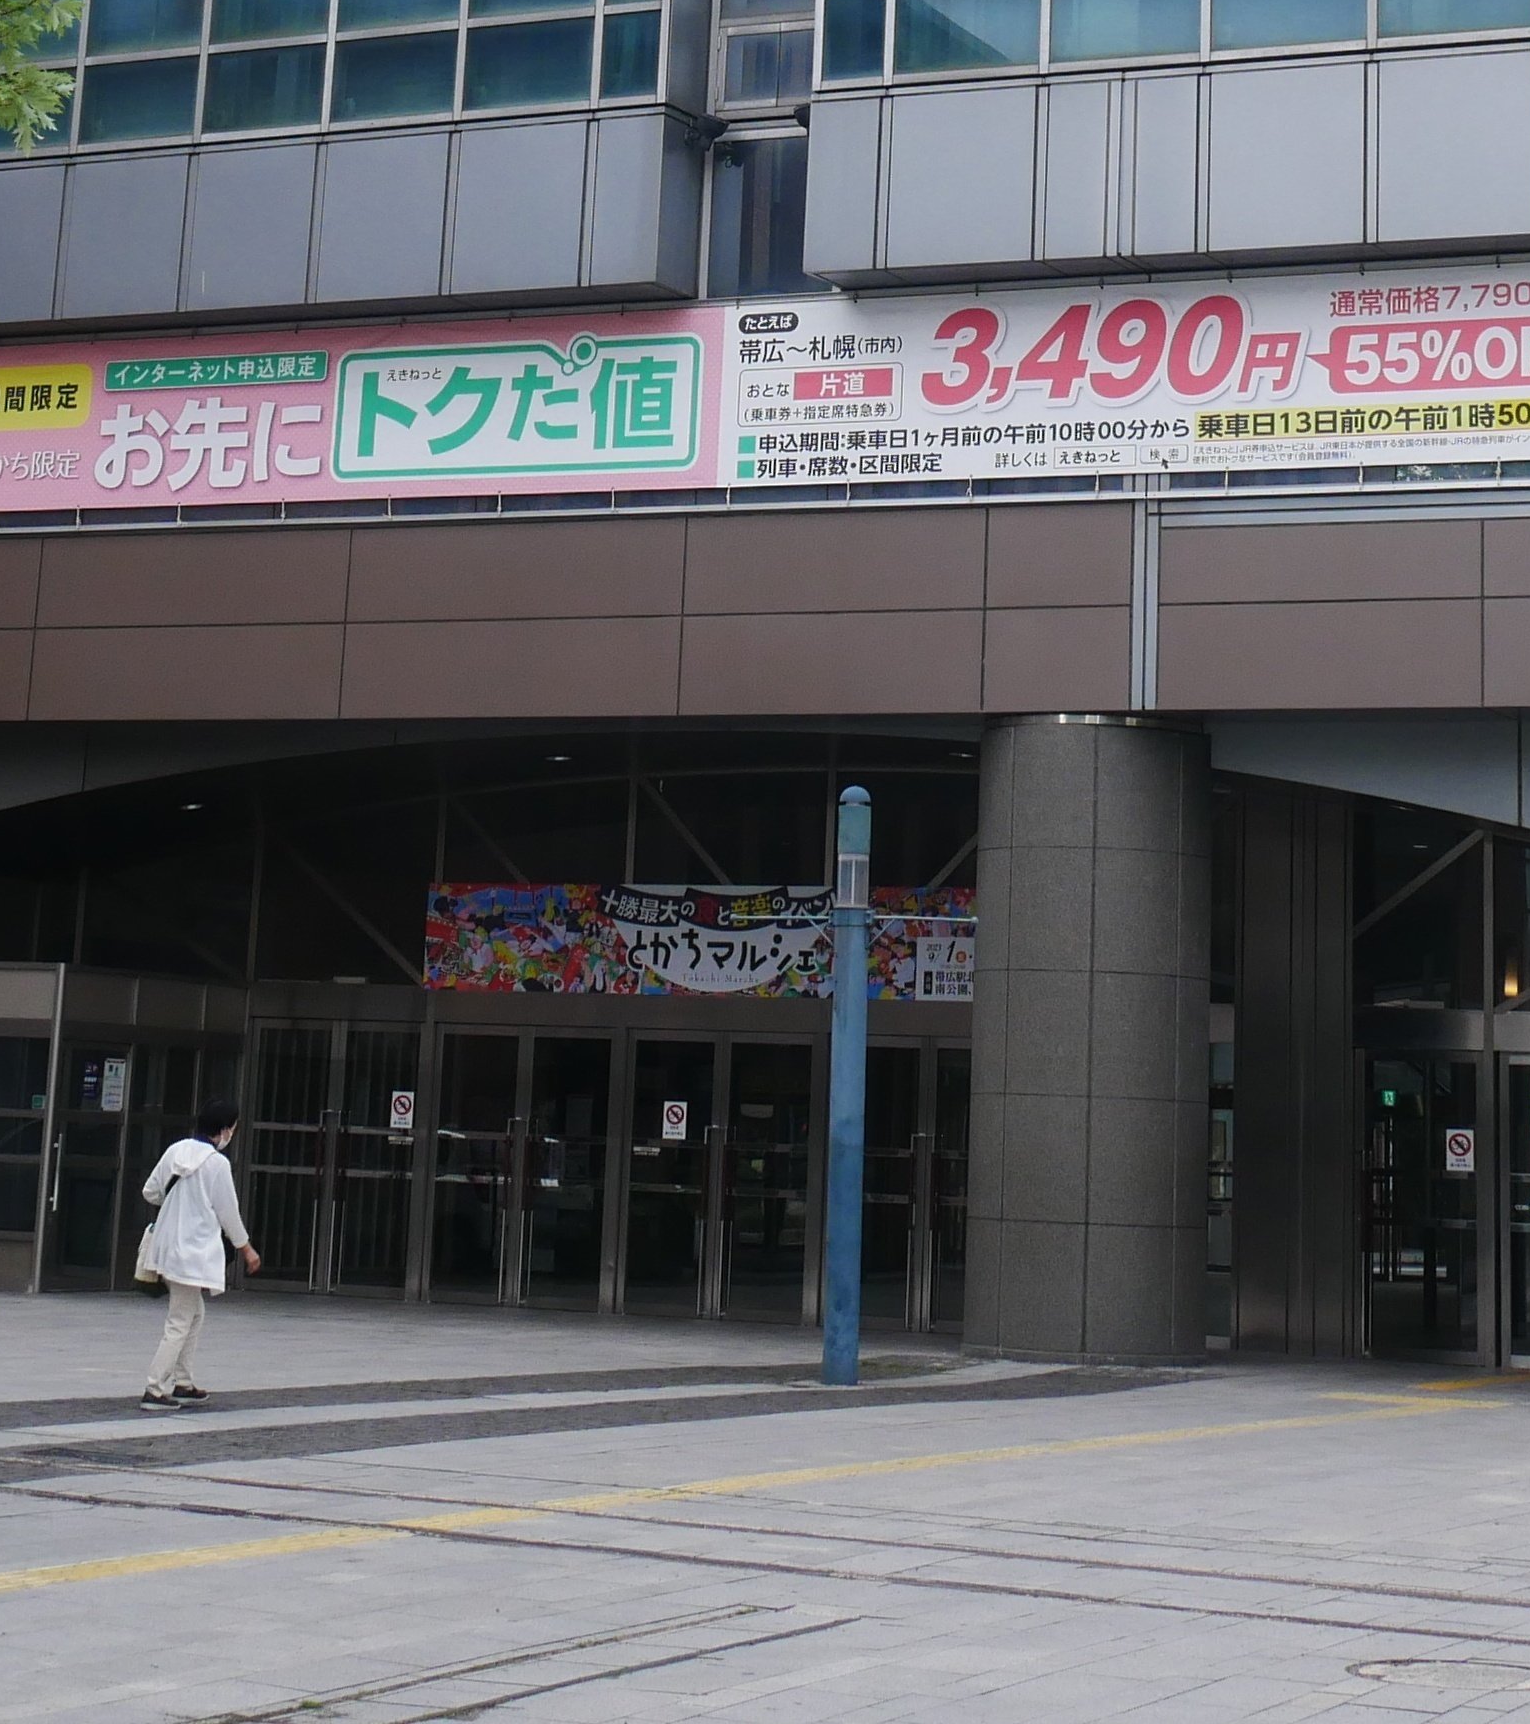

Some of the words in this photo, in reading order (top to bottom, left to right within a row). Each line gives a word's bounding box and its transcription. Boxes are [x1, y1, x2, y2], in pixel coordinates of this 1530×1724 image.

[744, 315, 794, 330] たとえば
[920, 294, 1303, 407] 3,490円
[114, 355, 317, 386] インターネット申込限定
[386, 367, 442, 383] えきねっと
[746, 382, 790, 398] おとな
[819, 371, 865, 397] 片道
[356, 340, 678, 458] トクだ値
[93, 396, 323, 492] お先に
[1058, 449, 1121, 465] えきねっと
[994, 451, 1048, 468] 詳しくは
[626, 928, 817, 972] とかちマルシェ
